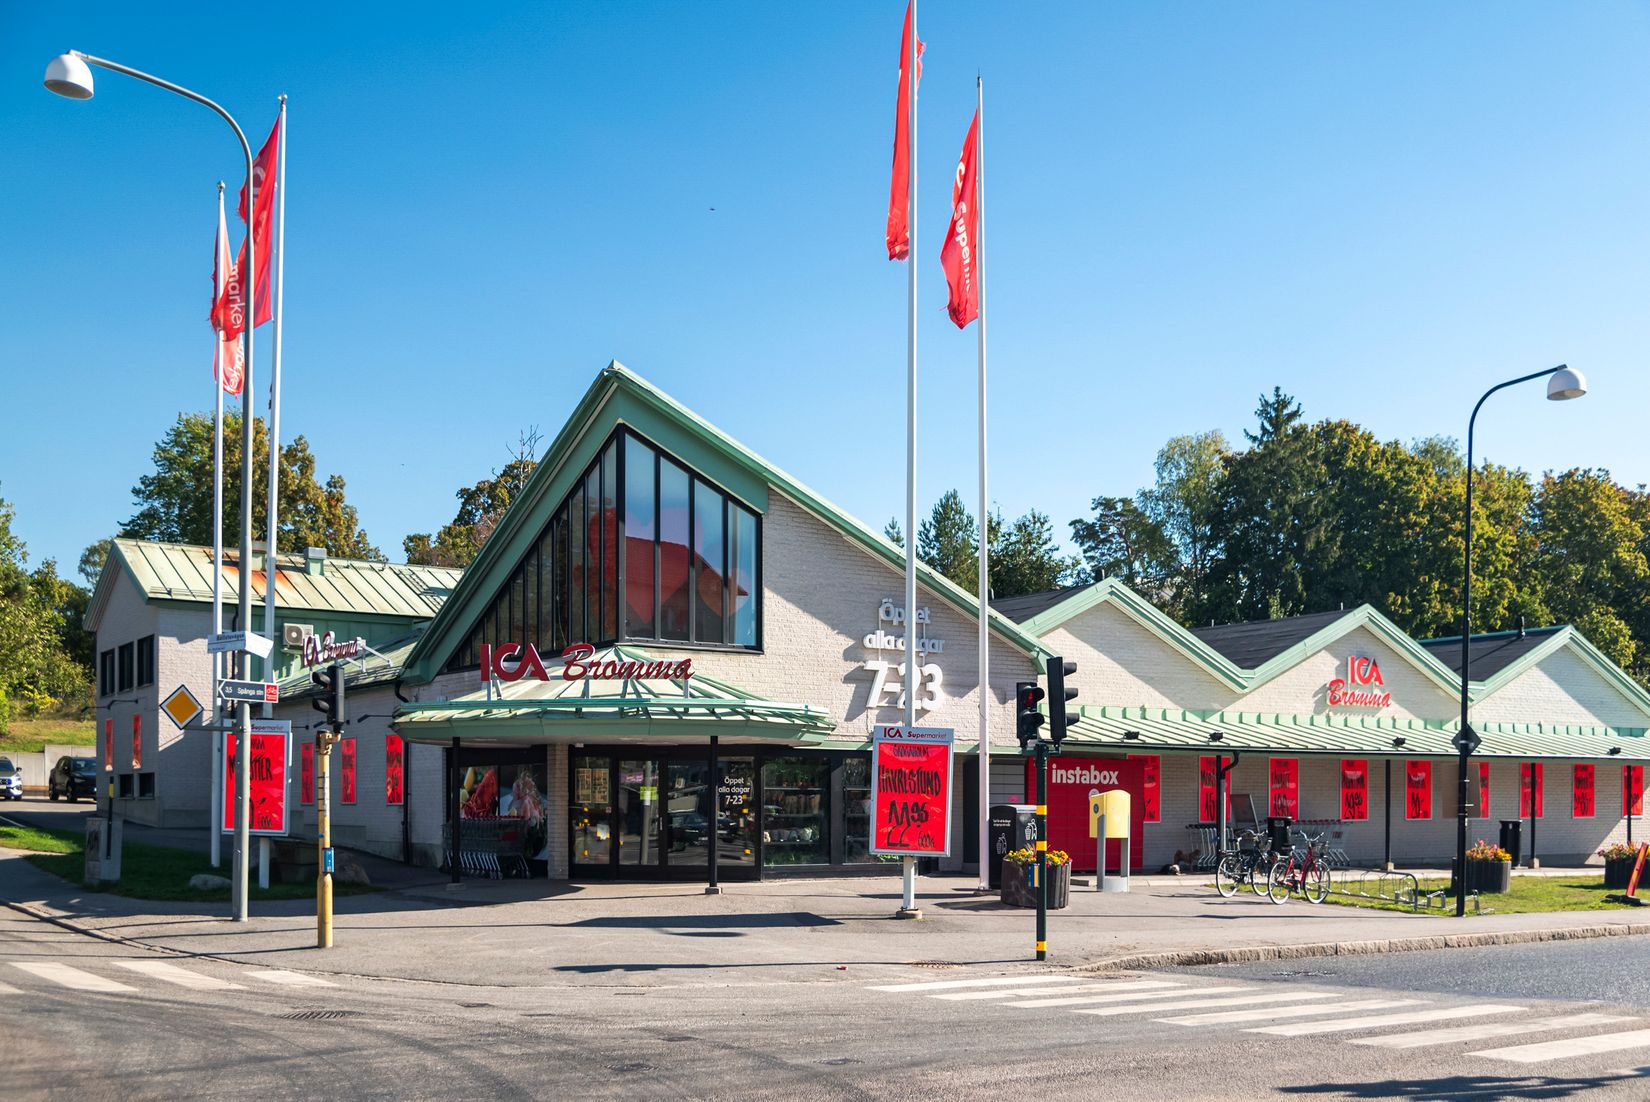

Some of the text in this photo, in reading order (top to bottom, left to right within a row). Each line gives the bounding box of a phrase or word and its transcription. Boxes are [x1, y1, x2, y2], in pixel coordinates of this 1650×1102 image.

[880, 598, 931, 626] Öpet
[863, 631, 895, 649] alla
[480, 642, 695, 682] ICA Bromma
[1348, 655, 1385, 686] ICA
[1327, 678, 1392, 707] Bromma
[883, 727, 947, 740] ICA Supermarket
[724, 776, 744, 785] Öppet
[1051, 763, 1119, 785] instabox
[725, 795, 744, 805] 7-23
[730, 786, 751, 794] dagar
